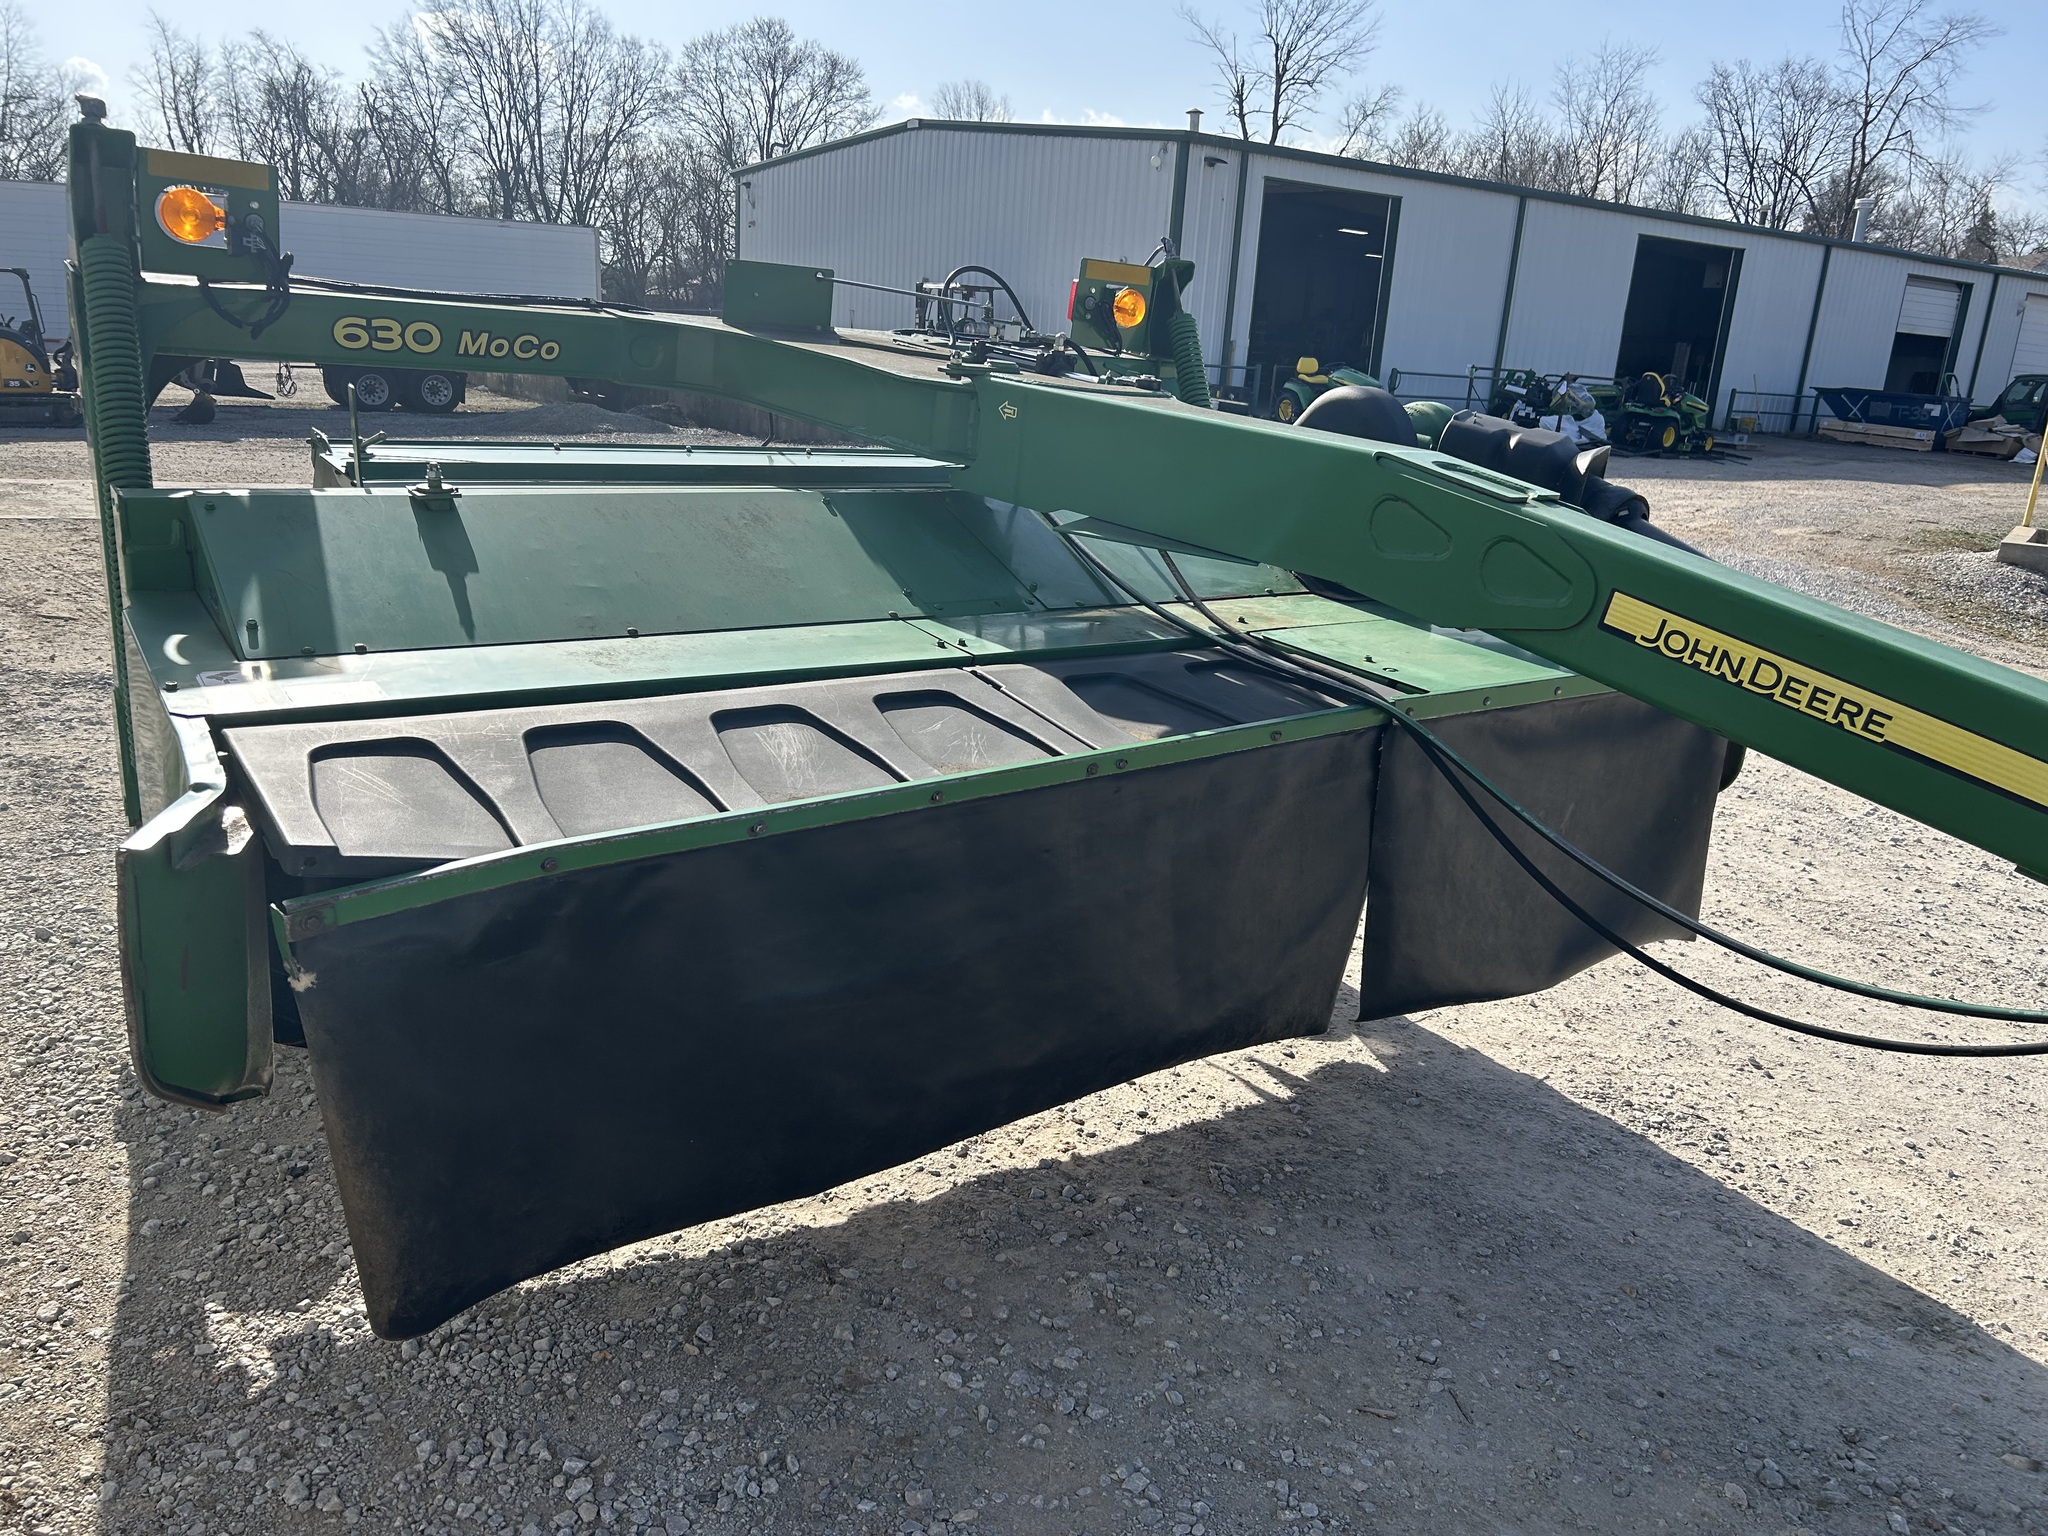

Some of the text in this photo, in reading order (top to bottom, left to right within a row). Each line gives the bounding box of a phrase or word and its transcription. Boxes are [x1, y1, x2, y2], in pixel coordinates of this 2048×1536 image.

[333, 316, 561, 360] 630 MoCo
[1639, 618, 1894, 739] JOHN DEERE
